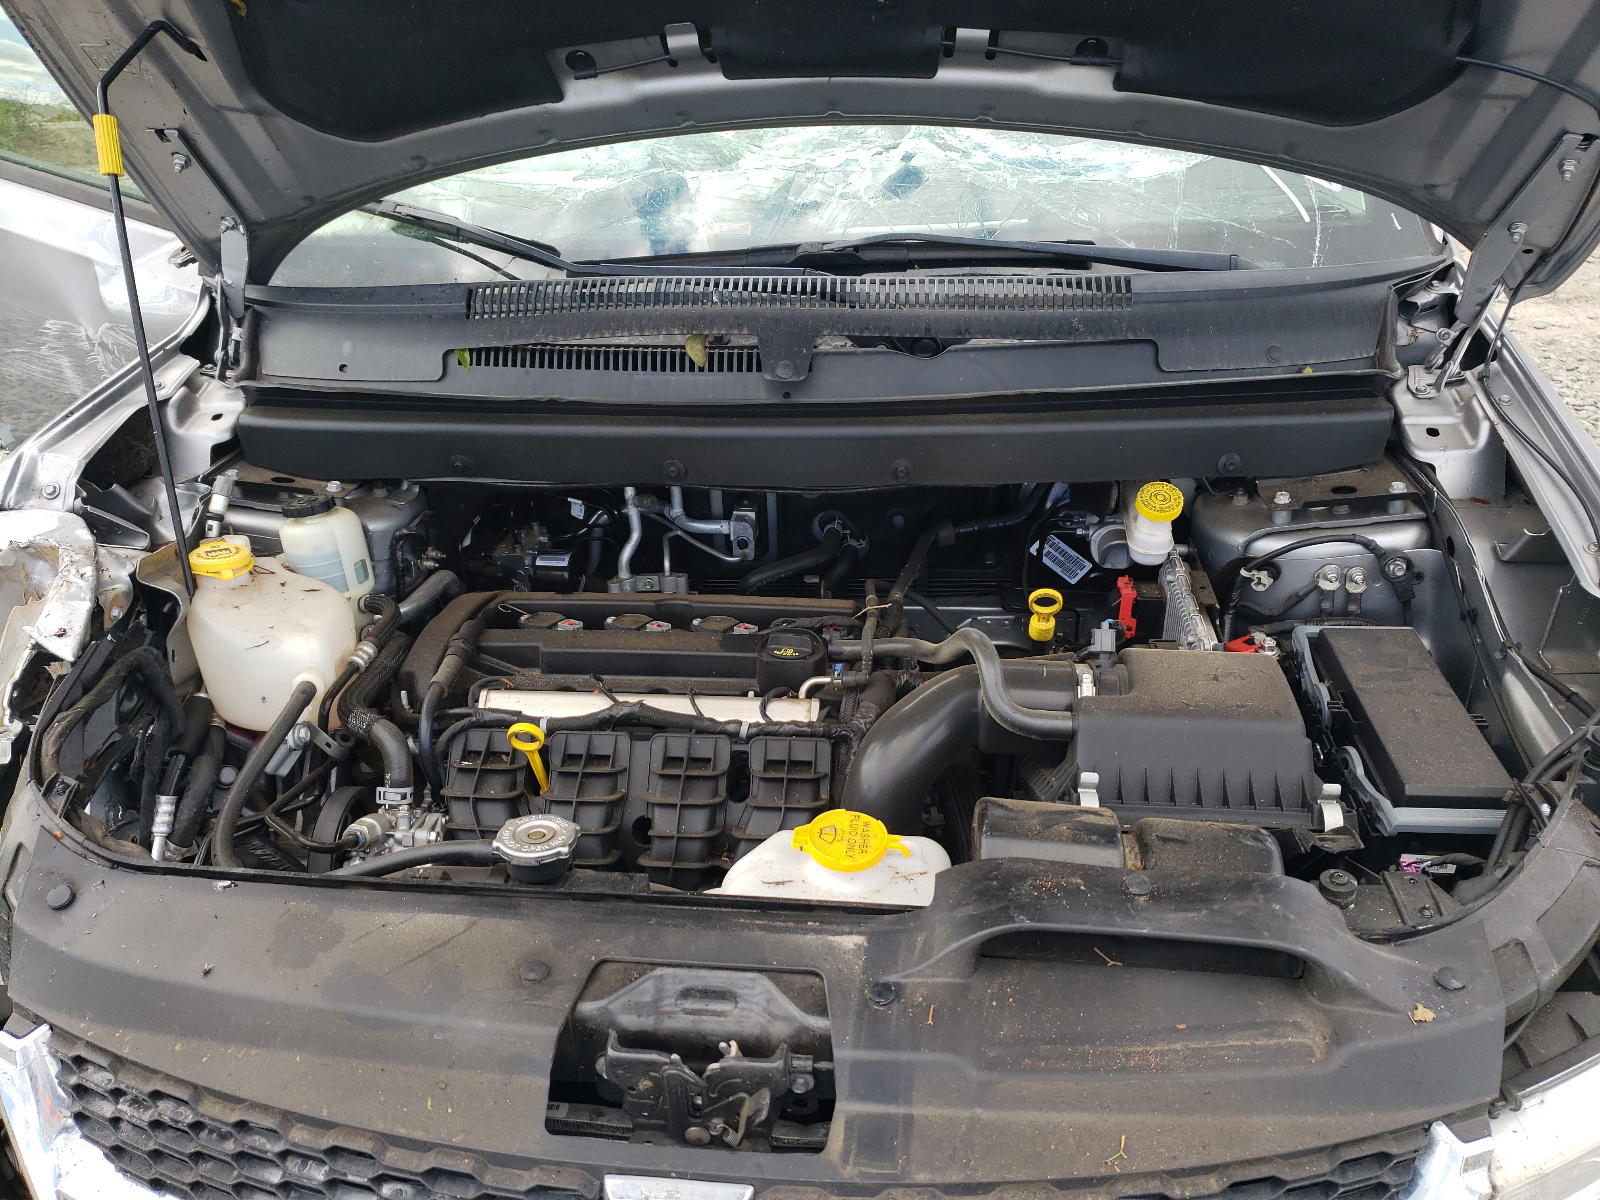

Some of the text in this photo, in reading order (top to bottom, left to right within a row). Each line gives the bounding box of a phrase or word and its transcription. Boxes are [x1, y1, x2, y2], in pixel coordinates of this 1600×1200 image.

[845, 814, 860, 859] FLUID ONLY
[859, 820, 872, 855] WASHER
